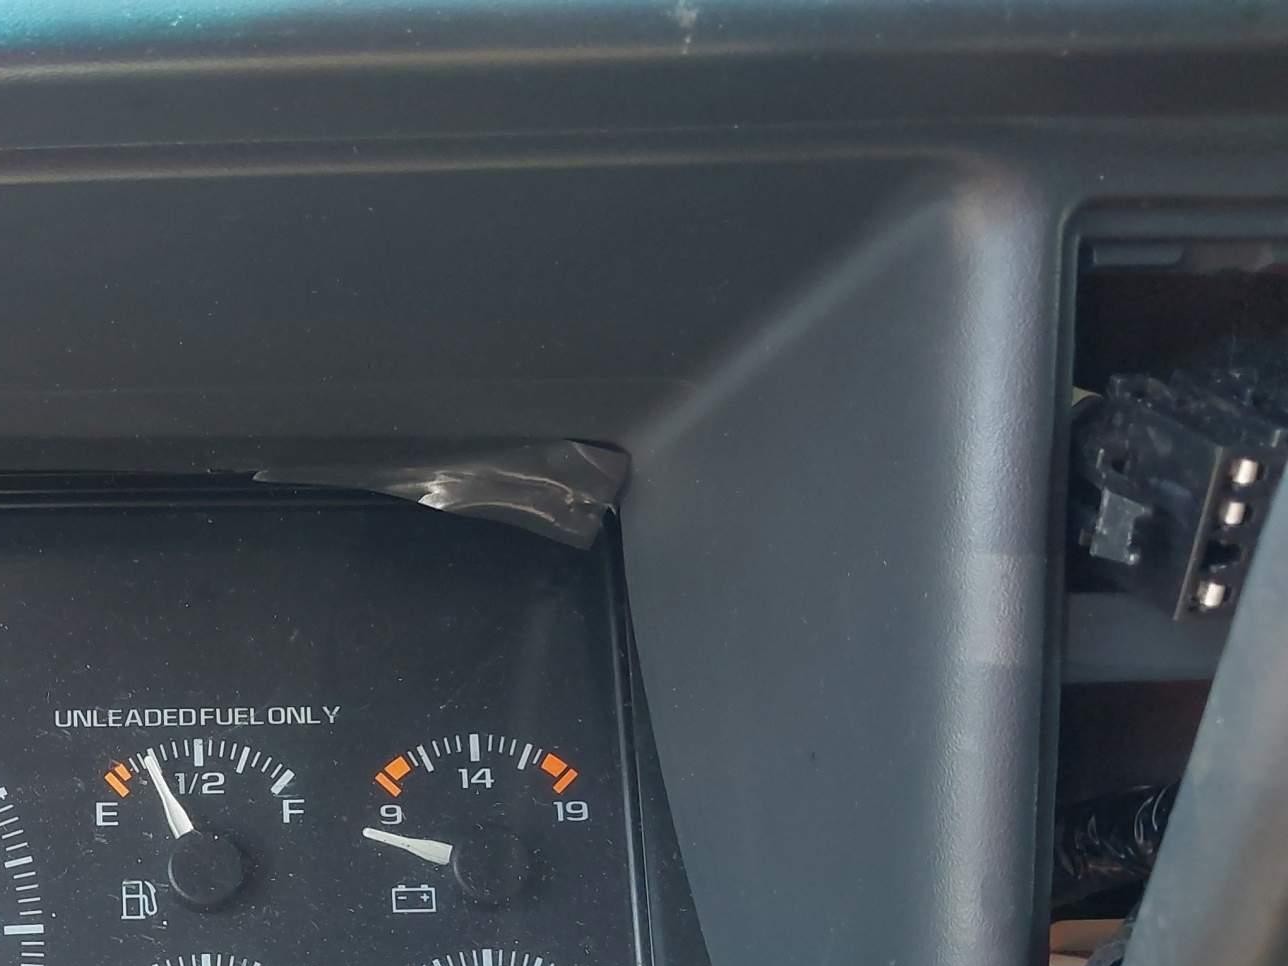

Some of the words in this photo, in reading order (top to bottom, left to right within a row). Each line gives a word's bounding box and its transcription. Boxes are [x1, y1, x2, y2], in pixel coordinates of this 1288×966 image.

[56, 709, 196, 727] UNLEADED
[201, 708, 264, 725] FUEL
[269, 707, 339, 724] ONLY
[175, 773, 224, 794] 1/2
[459, 769, 494, 788] 14
[96, 803, 118, 825] E
[283, 800, 304, 823] F
[381, 805, 402, 824] 9
[554, 802, 588, 821] 19
